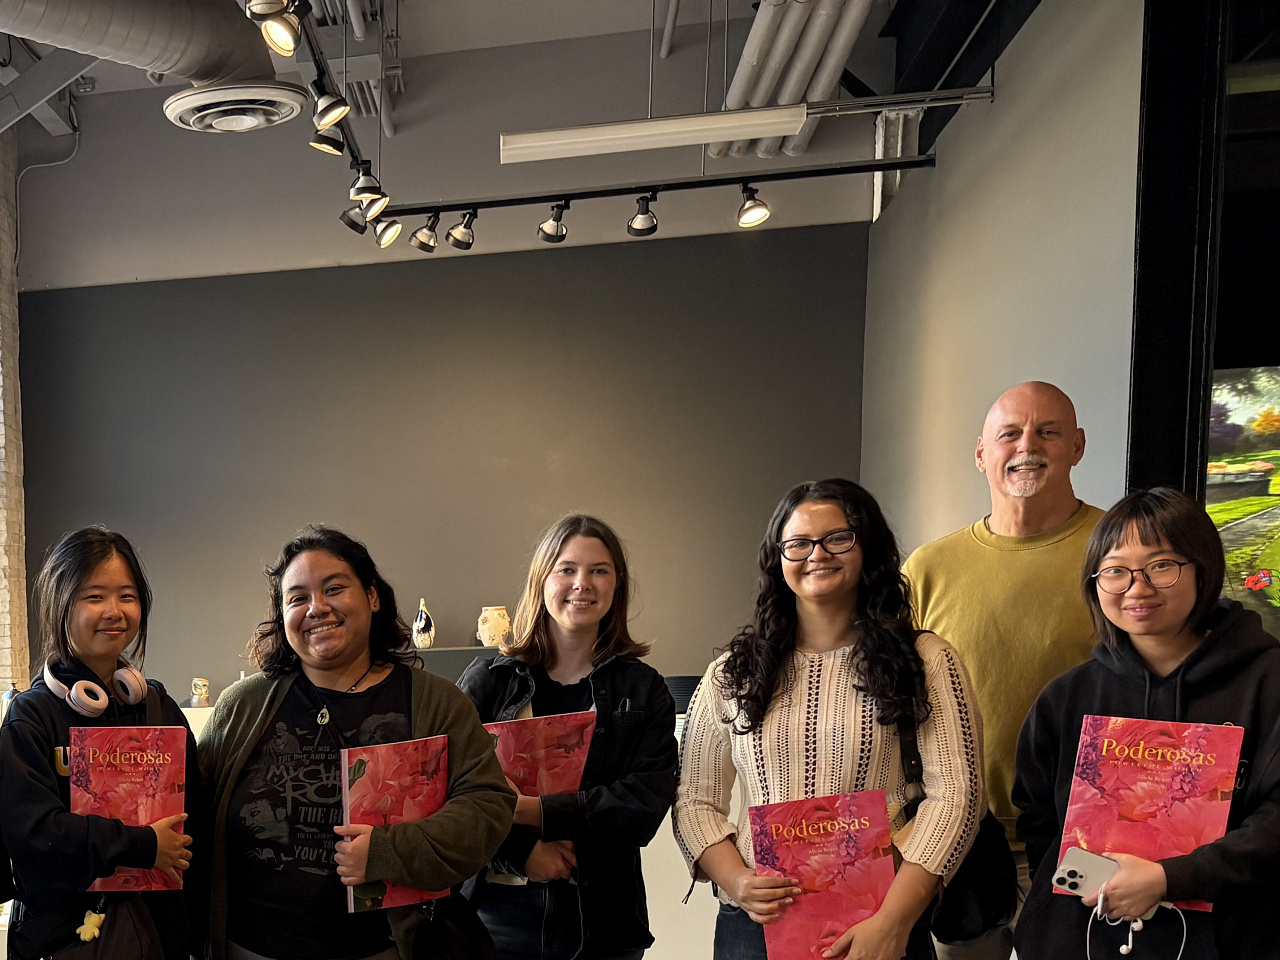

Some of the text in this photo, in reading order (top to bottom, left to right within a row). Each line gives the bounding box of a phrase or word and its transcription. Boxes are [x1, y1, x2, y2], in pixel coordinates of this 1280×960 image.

[88, 747, 172, 764] Poderosas
[1101, 738, 1217, 767] Poderosas
[297, 806, 326, 823] THE
[771, 816, 870, 840] Poderosas
